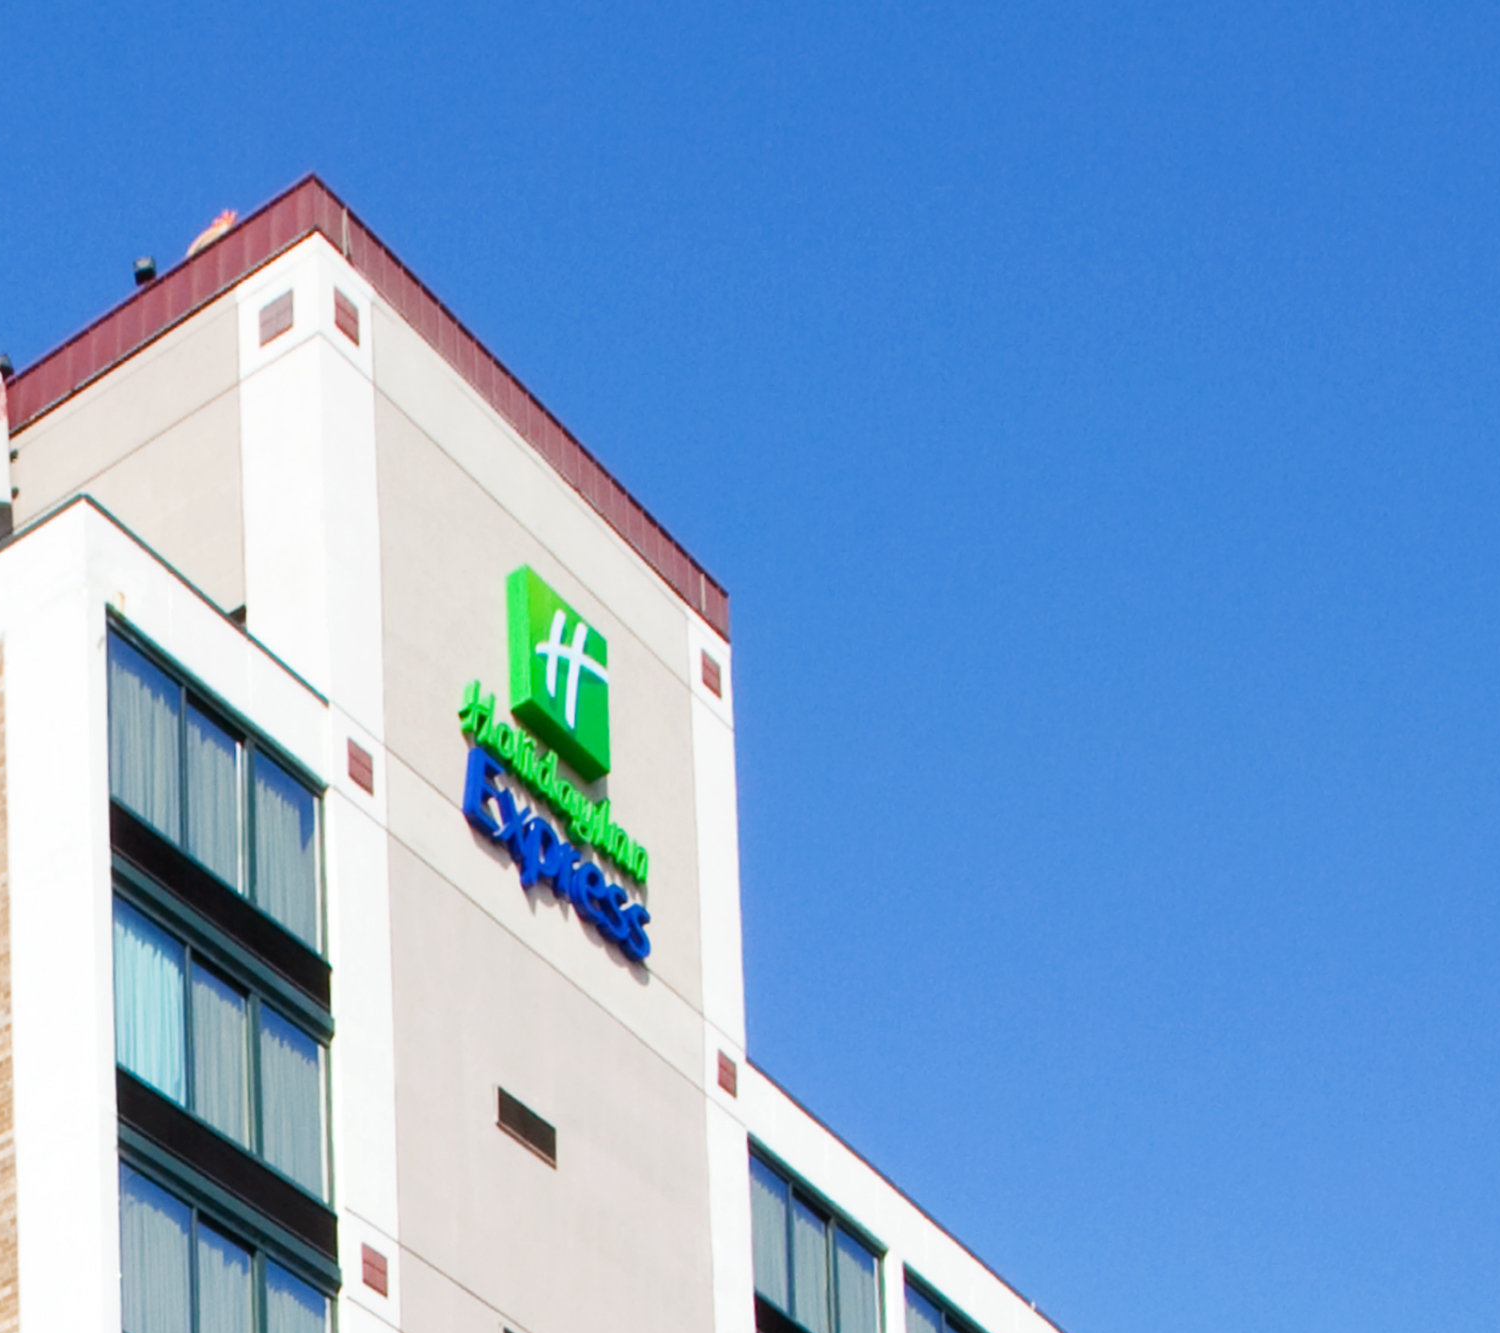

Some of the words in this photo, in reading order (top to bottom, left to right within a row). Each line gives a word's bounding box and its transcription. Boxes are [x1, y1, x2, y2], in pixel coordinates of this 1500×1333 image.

[458, 679, 592, 846] Holiday
[591, 797, 649, 885] Inn
[463, 746, 651, 963] Express
